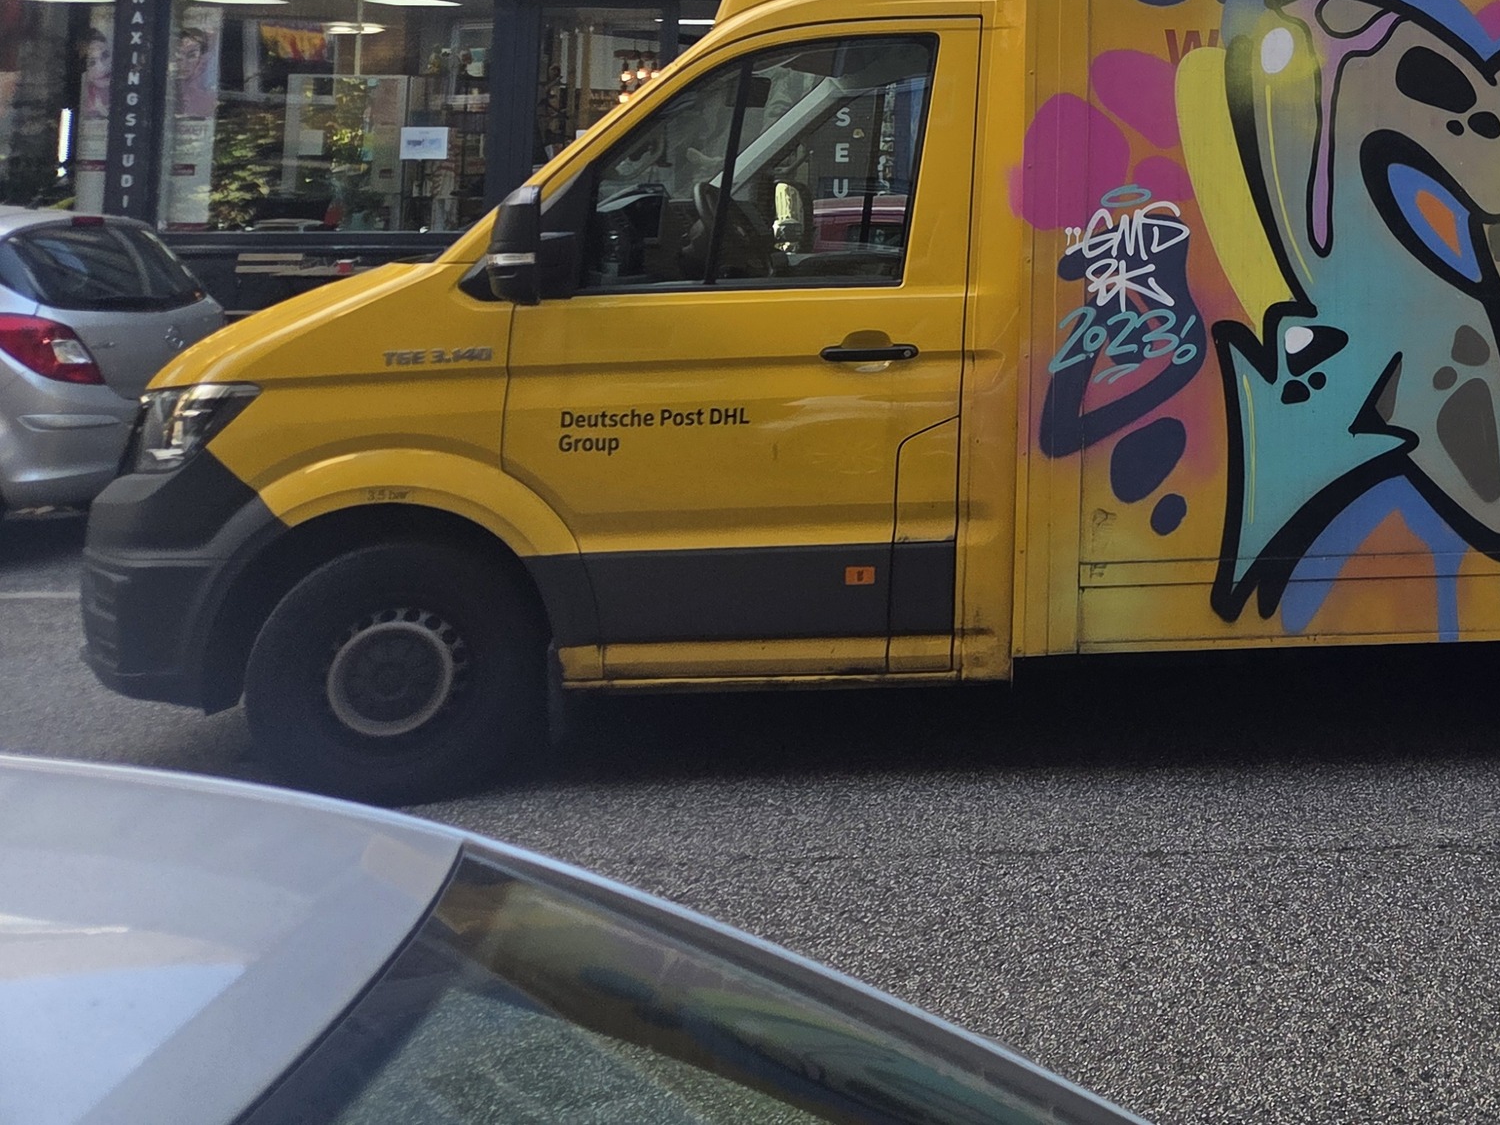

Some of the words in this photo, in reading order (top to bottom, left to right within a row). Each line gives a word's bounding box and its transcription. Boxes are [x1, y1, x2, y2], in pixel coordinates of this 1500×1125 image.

[1047, 306, 1198, 374] 2023!
[560, 409, 655, 429] Deutsche
[659, 408, 704, 427] Post
[709, 407, 751, 426] DHL
[558, 433, 621, 456] Group
